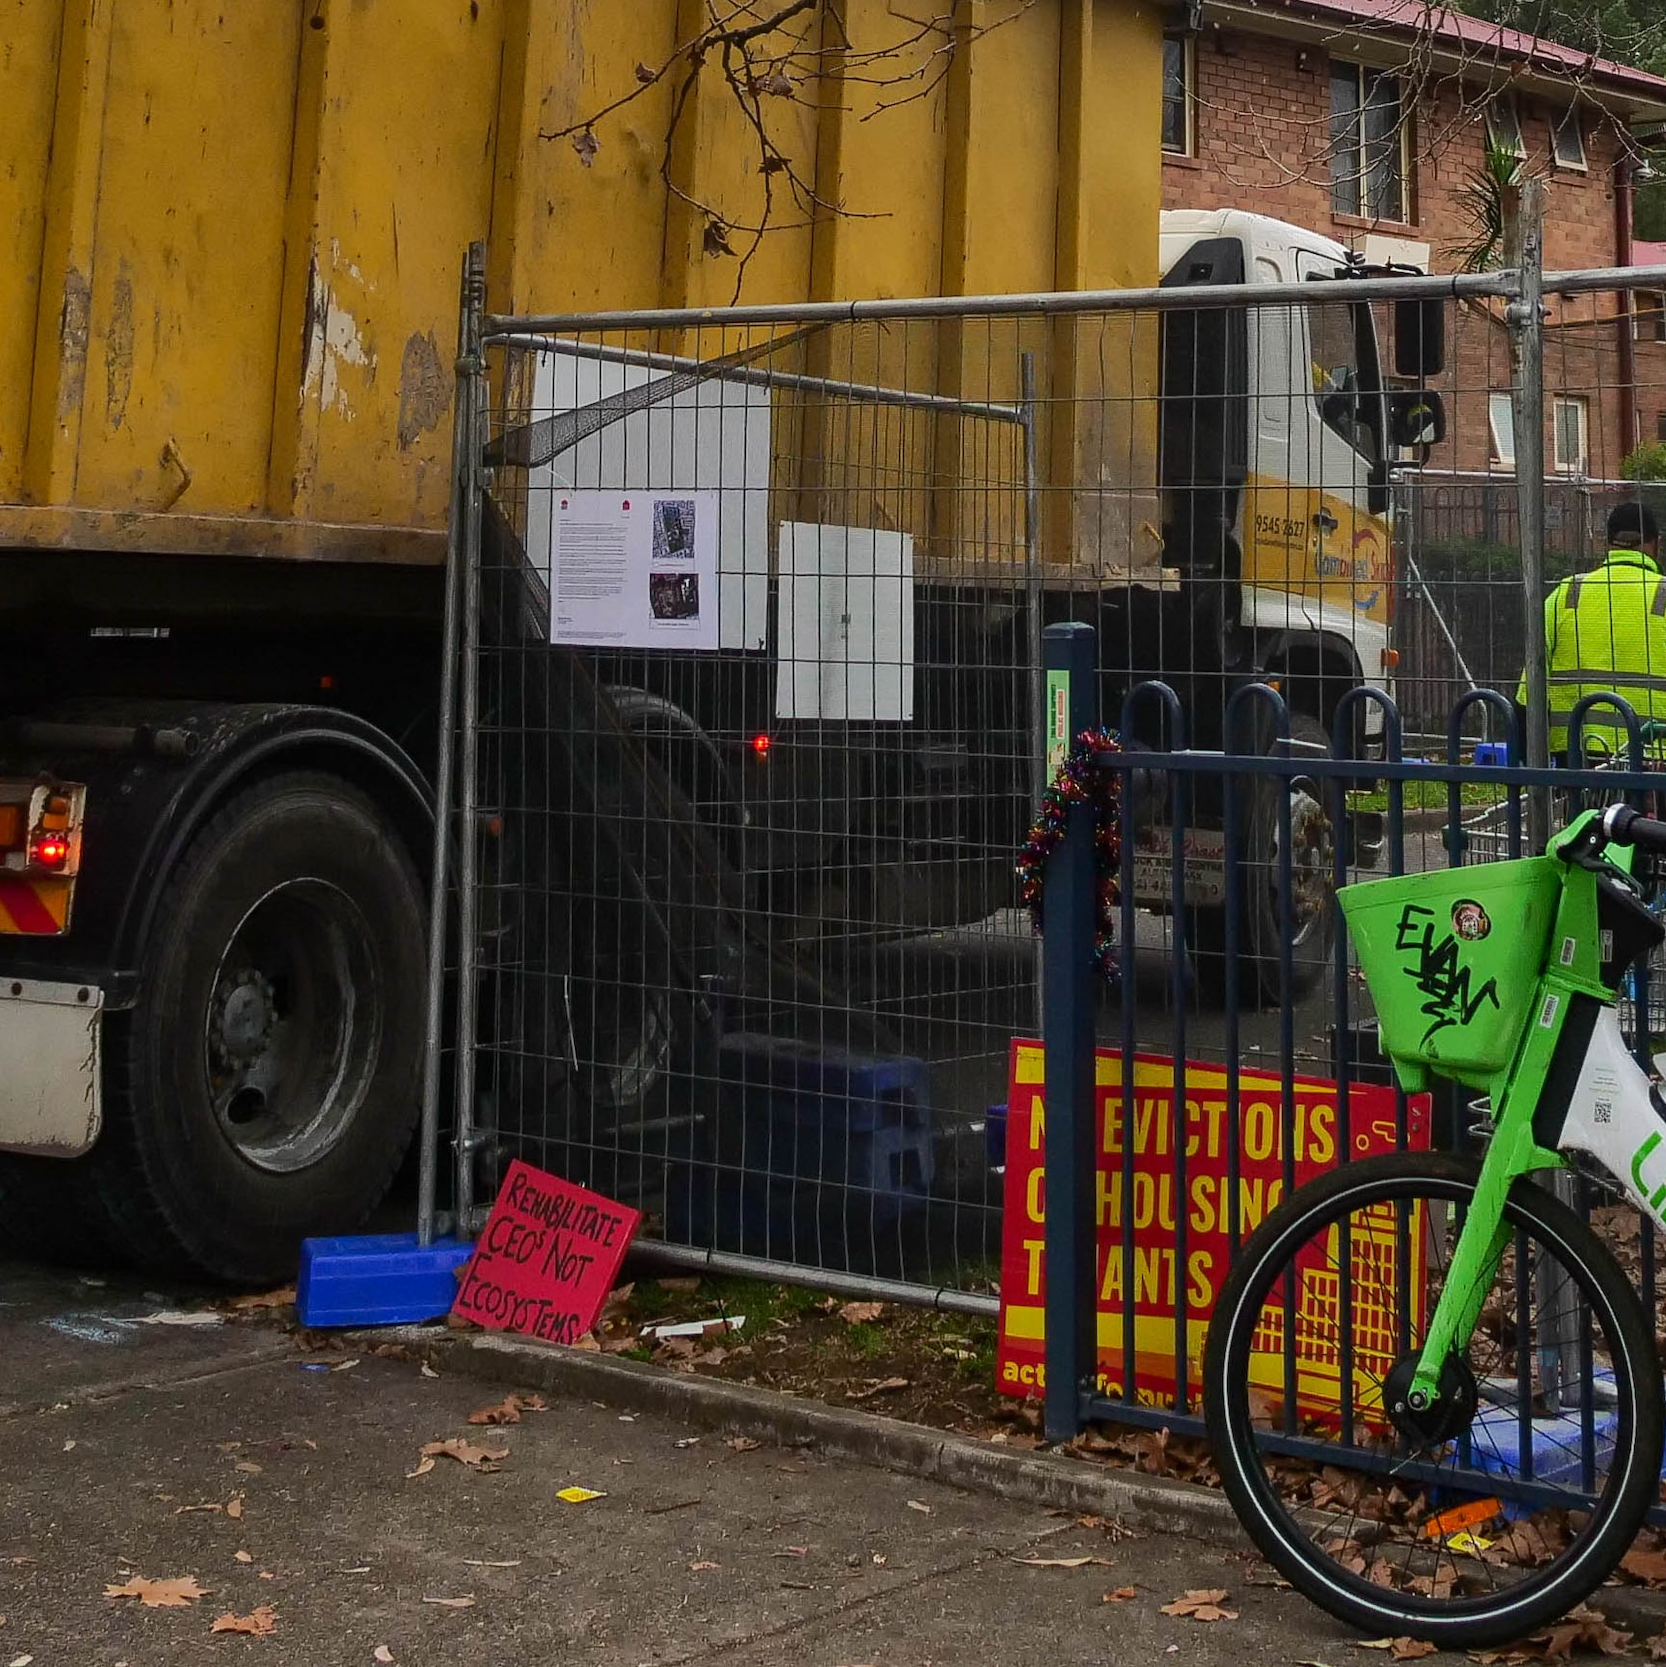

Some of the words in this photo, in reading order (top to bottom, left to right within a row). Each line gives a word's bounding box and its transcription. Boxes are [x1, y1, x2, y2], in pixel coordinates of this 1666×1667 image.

[1256, 514, 1280, 534] 9545
[1102, 1096, 1336, 1164] EVICTONS
[505, 1171, 623, 1248] REHABILITATE
[540, 1232, 595, 1289] NOT
[1023, 1239, 1213, 1309] TANTS
